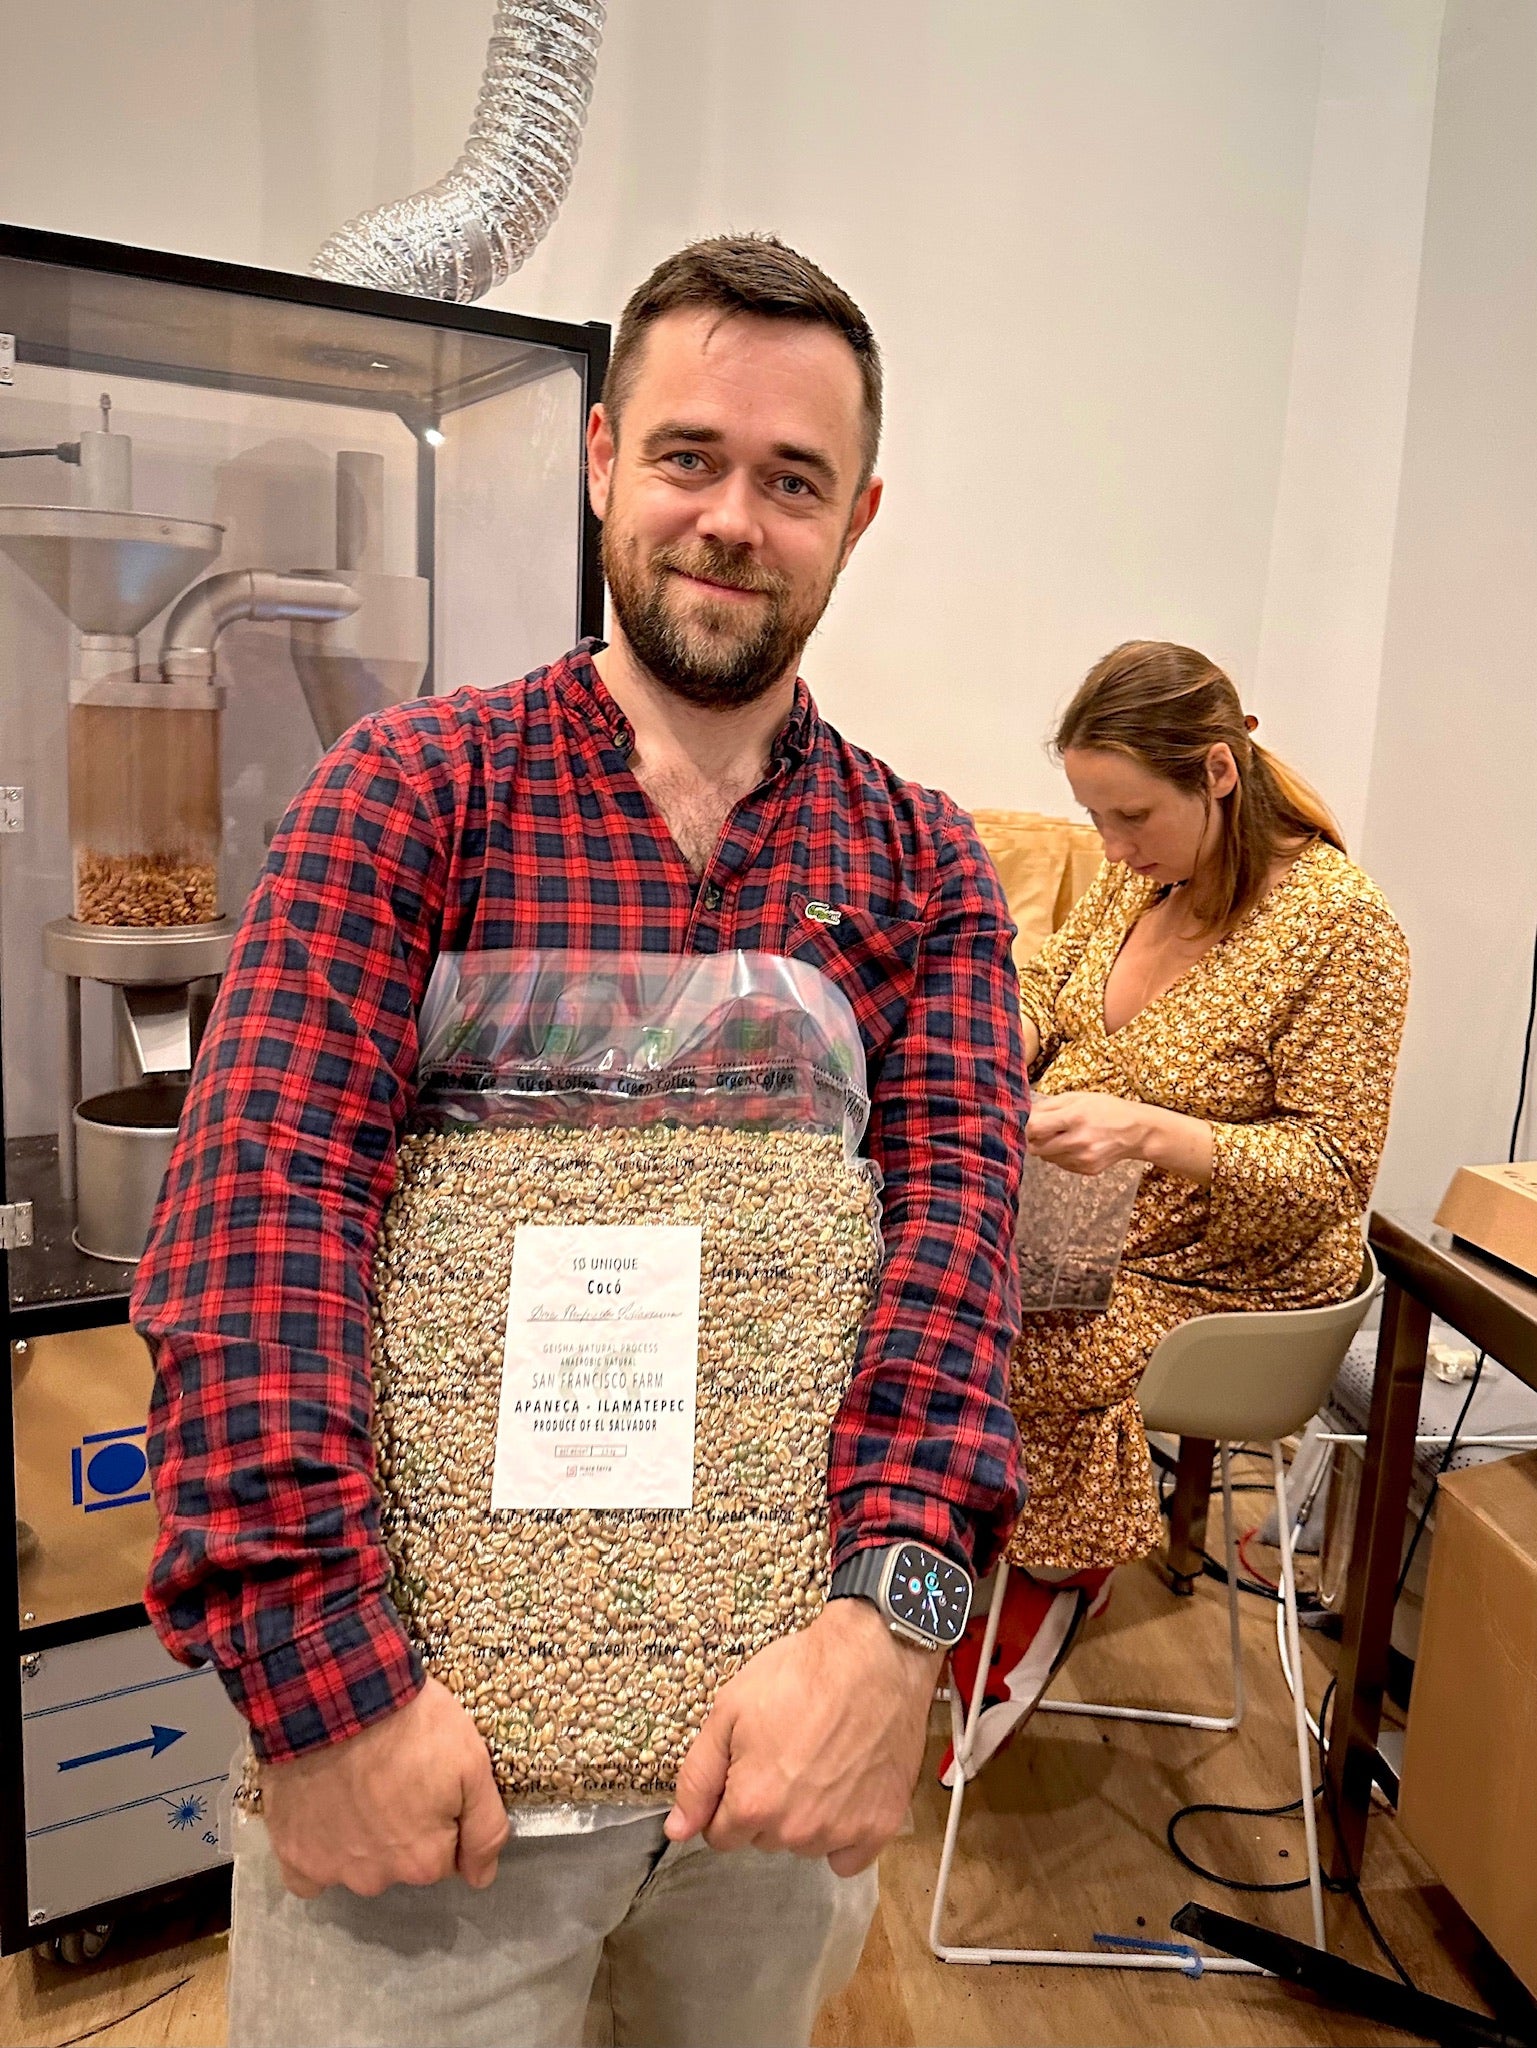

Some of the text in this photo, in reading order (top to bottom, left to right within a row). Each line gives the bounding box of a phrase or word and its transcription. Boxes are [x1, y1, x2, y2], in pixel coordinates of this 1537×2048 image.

[617, 1076, 653, 1096] Green
[716, 1071, 794, 1089] Green Coffee
[590, 1257, 639, 1273] UNIQUE
[587, 1279, 622, 1295] Cocó
[543, 1342, 659, 1354] GEISHA NATURAL PROCESS
[560, 1356, 637, 1367] ANAEROBIC NATURAL
[532, 1372, 664, 1390] SAN FRANCISCO FARM
[514, 1400, 580, 1414] APANECA
[598, 1399, 686, 1413] ILAMATEPEC
[533, 1418, 658, 1432] PRODUCE OF EL SALVADOR
